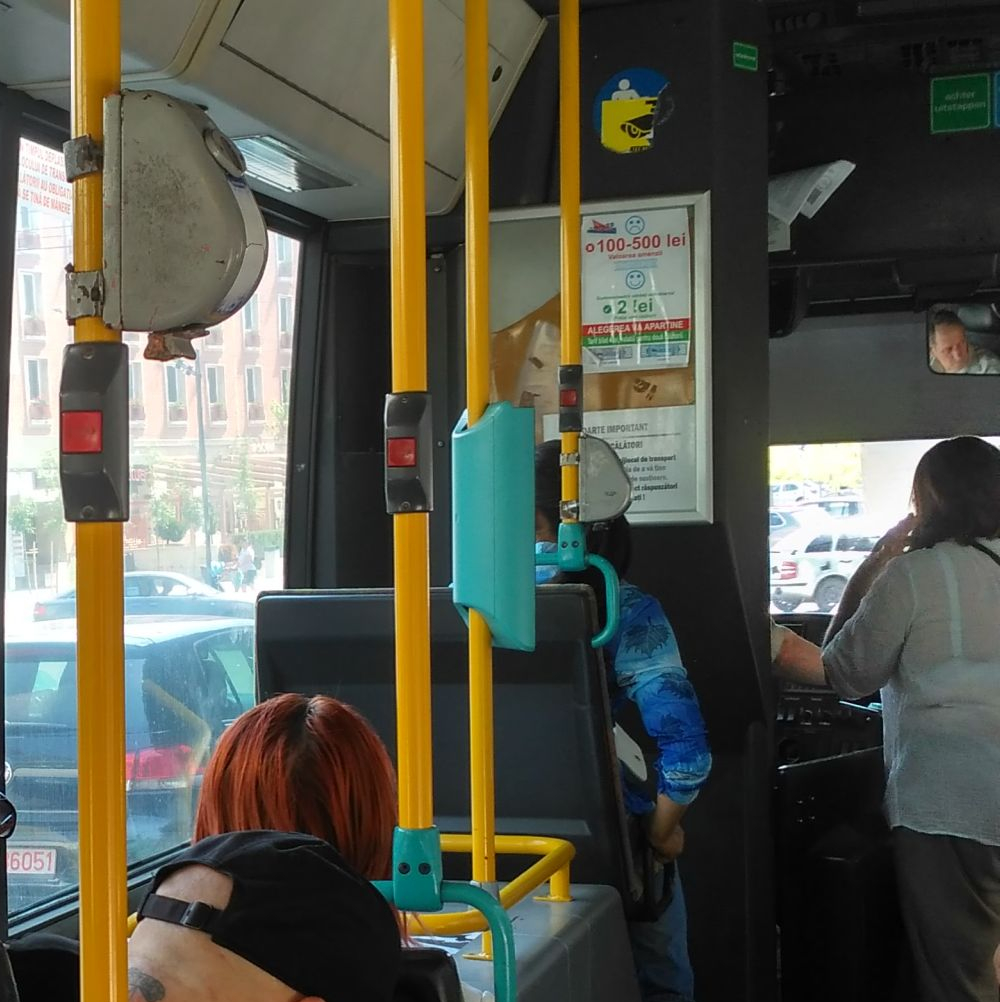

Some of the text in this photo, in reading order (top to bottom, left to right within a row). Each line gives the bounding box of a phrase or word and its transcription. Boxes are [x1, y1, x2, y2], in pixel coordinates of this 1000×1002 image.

[597, 232, 686, 253] 100-500 lei
[617, 299, 627, 314] 2
[607, 423, 648, 434] IMPORTANT
[8, 851, 53, 871] 6051
